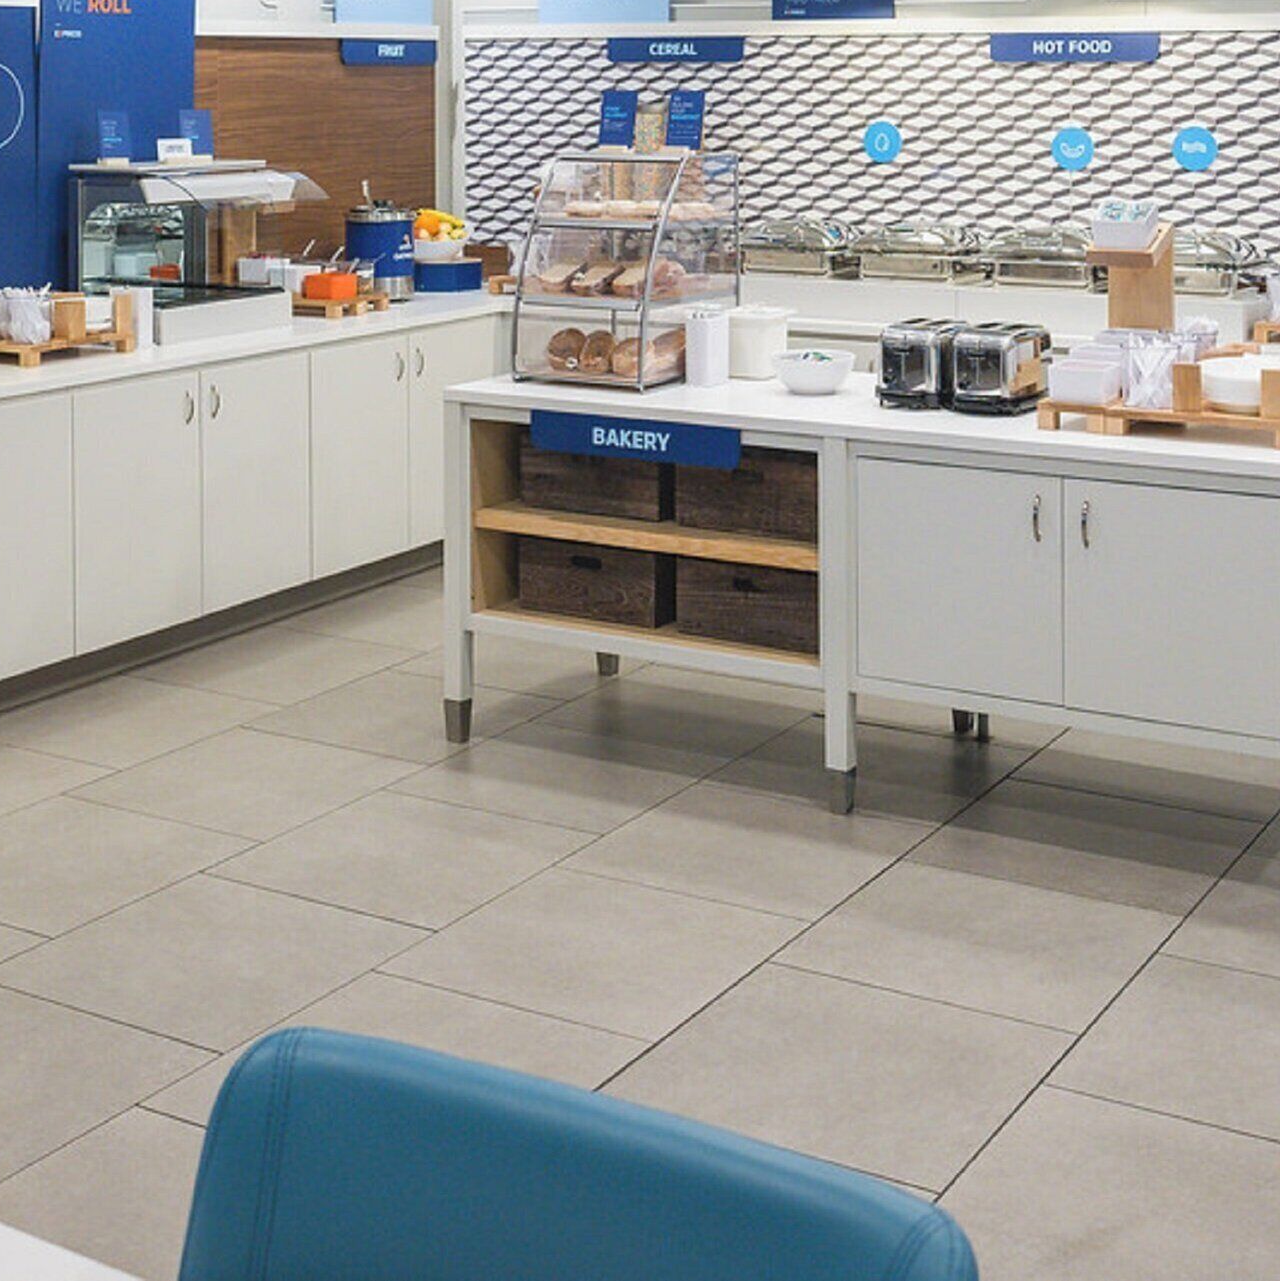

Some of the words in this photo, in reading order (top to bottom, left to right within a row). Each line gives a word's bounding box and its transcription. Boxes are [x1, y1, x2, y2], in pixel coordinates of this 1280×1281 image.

[378, 43, 406, 58] FRUIT
[648, 41, 698, 56] CEREAL
[1032, 39, 1065, 55] HOT
[1068, 39, 1112, 54] FOOD
[592, 426, 670, 452] BAKERY
